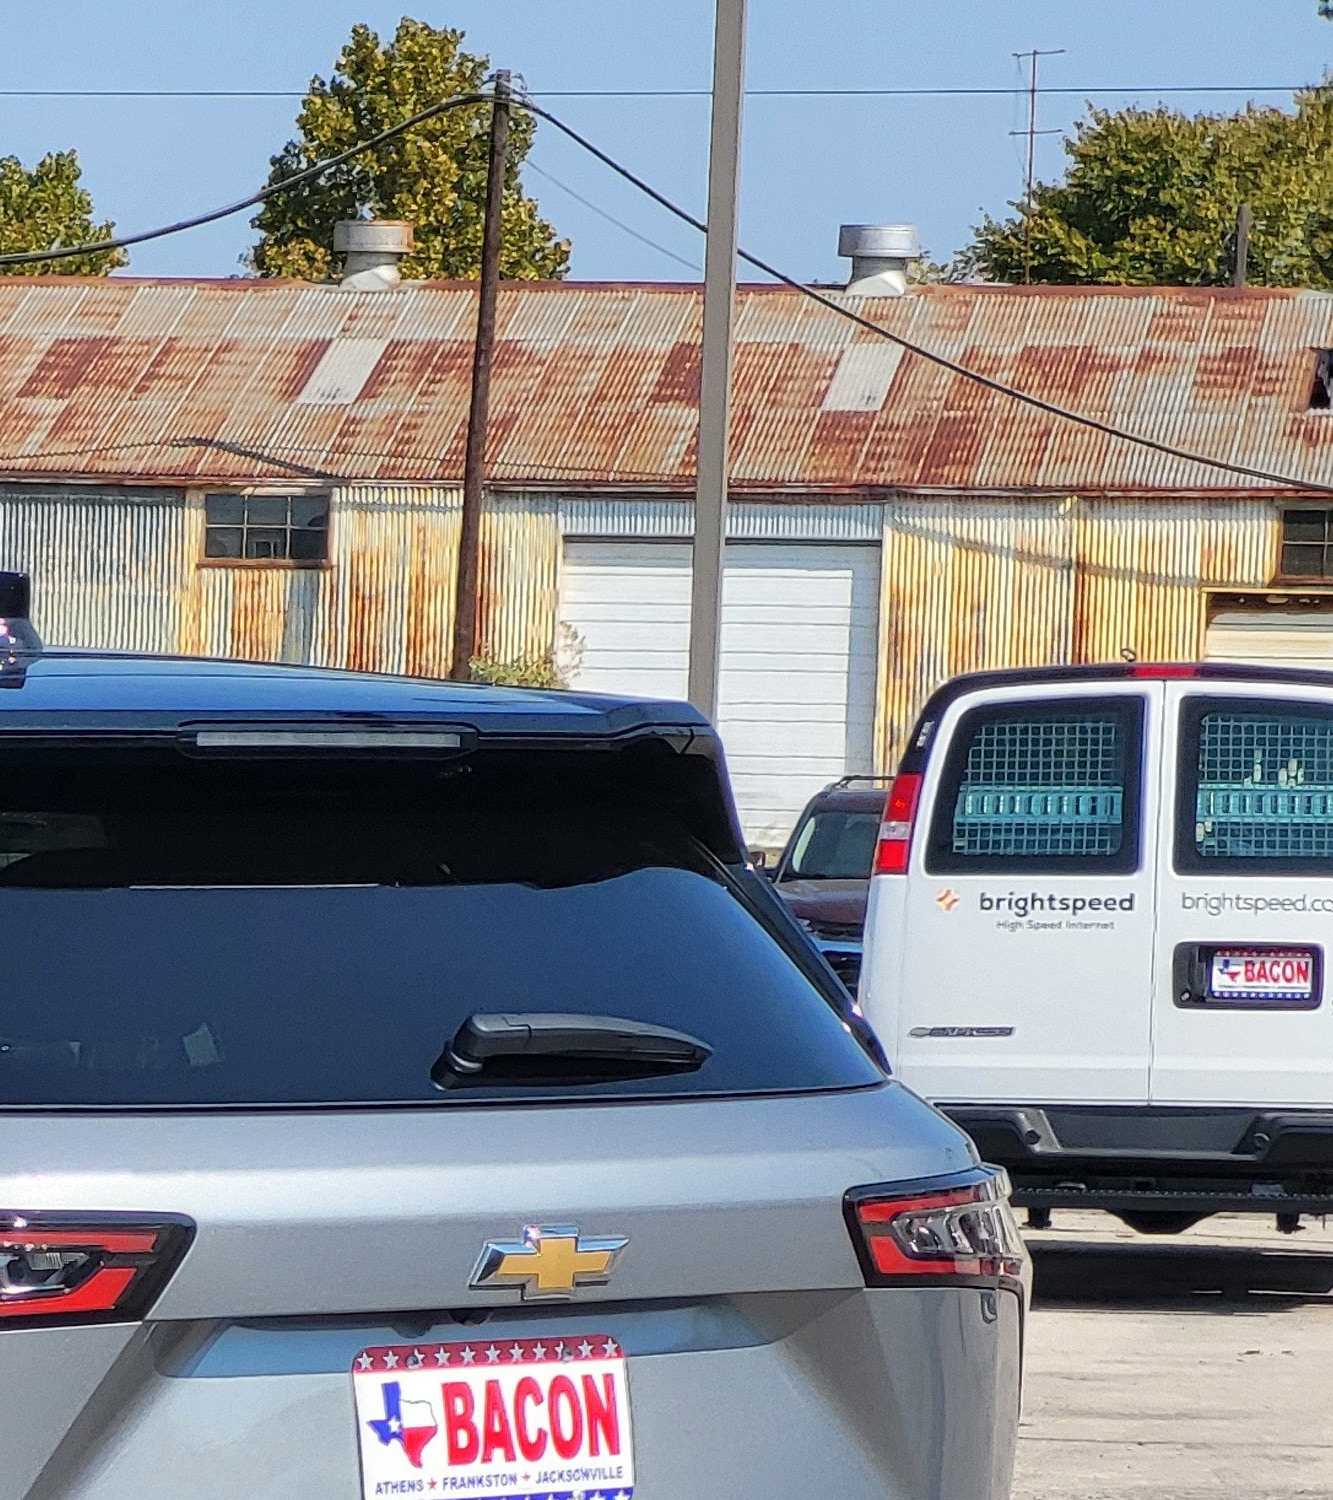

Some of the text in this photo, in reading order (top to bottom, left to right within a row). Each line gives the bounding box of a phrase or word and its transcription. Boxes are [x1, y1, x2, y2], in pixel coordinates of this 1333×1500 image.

[979, 891, 1135, 917] brightspeed
[996, 920, 1024, 933] High
[1025, 920, 1062, 932] Speed
[1244, 960, 1310, 983] BACON
[440, 1372, 621, 1467] BACON
[374, 1465, 624, 1497] ATHENS FRANKSTON JACKSONVILLE
